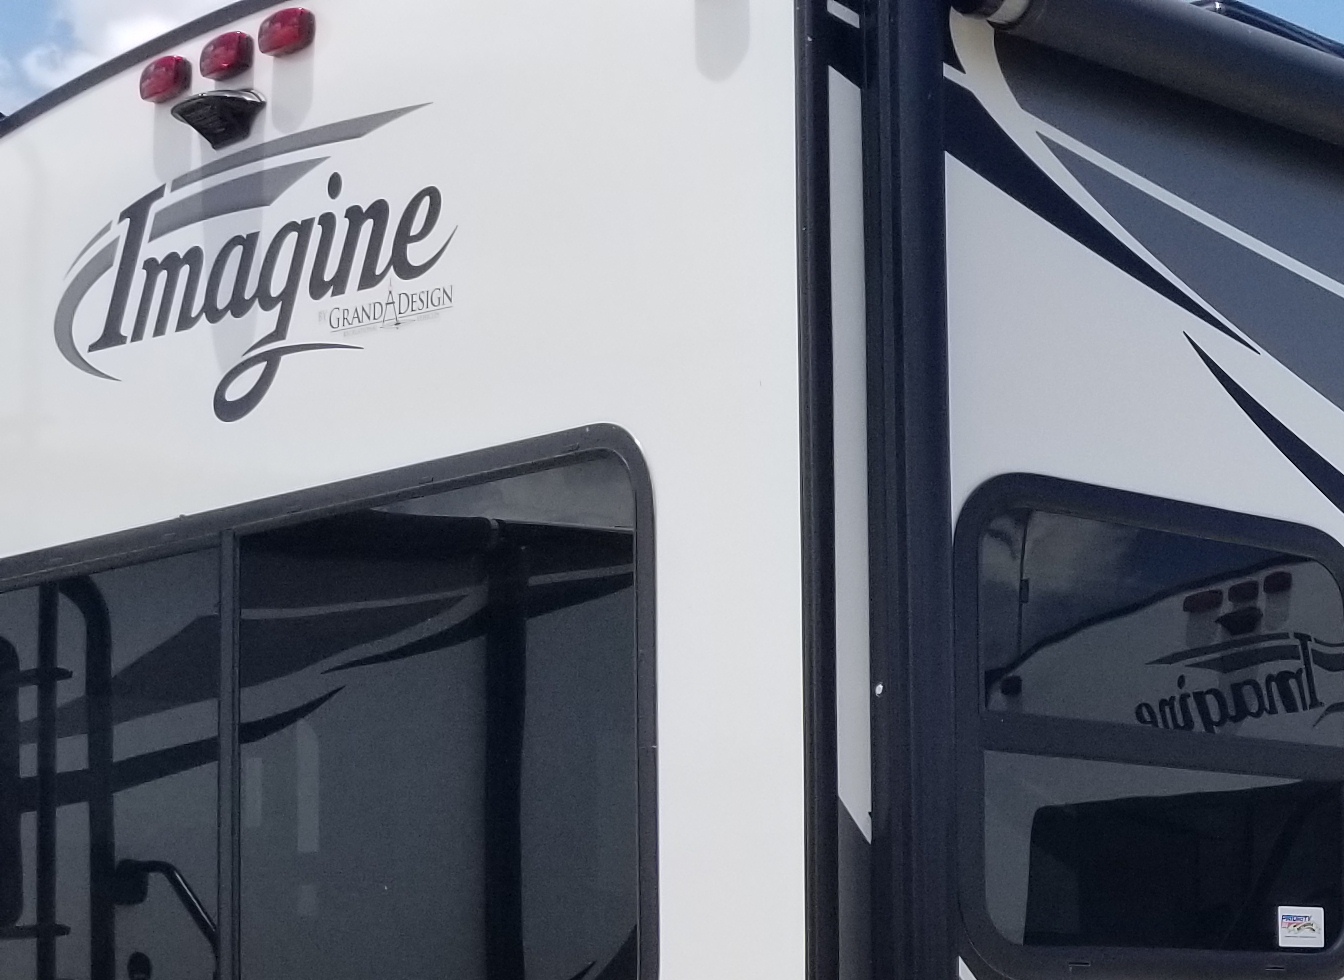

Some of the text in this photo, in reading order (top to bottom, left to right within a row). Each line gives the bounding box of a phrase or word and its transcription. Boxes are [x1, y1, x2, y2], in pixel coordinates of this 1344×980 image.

[87, 171, 458, 423] Imagine
[329, 301, 384, 329] GRAND
[398, 285, 453, 315] DESIGN
